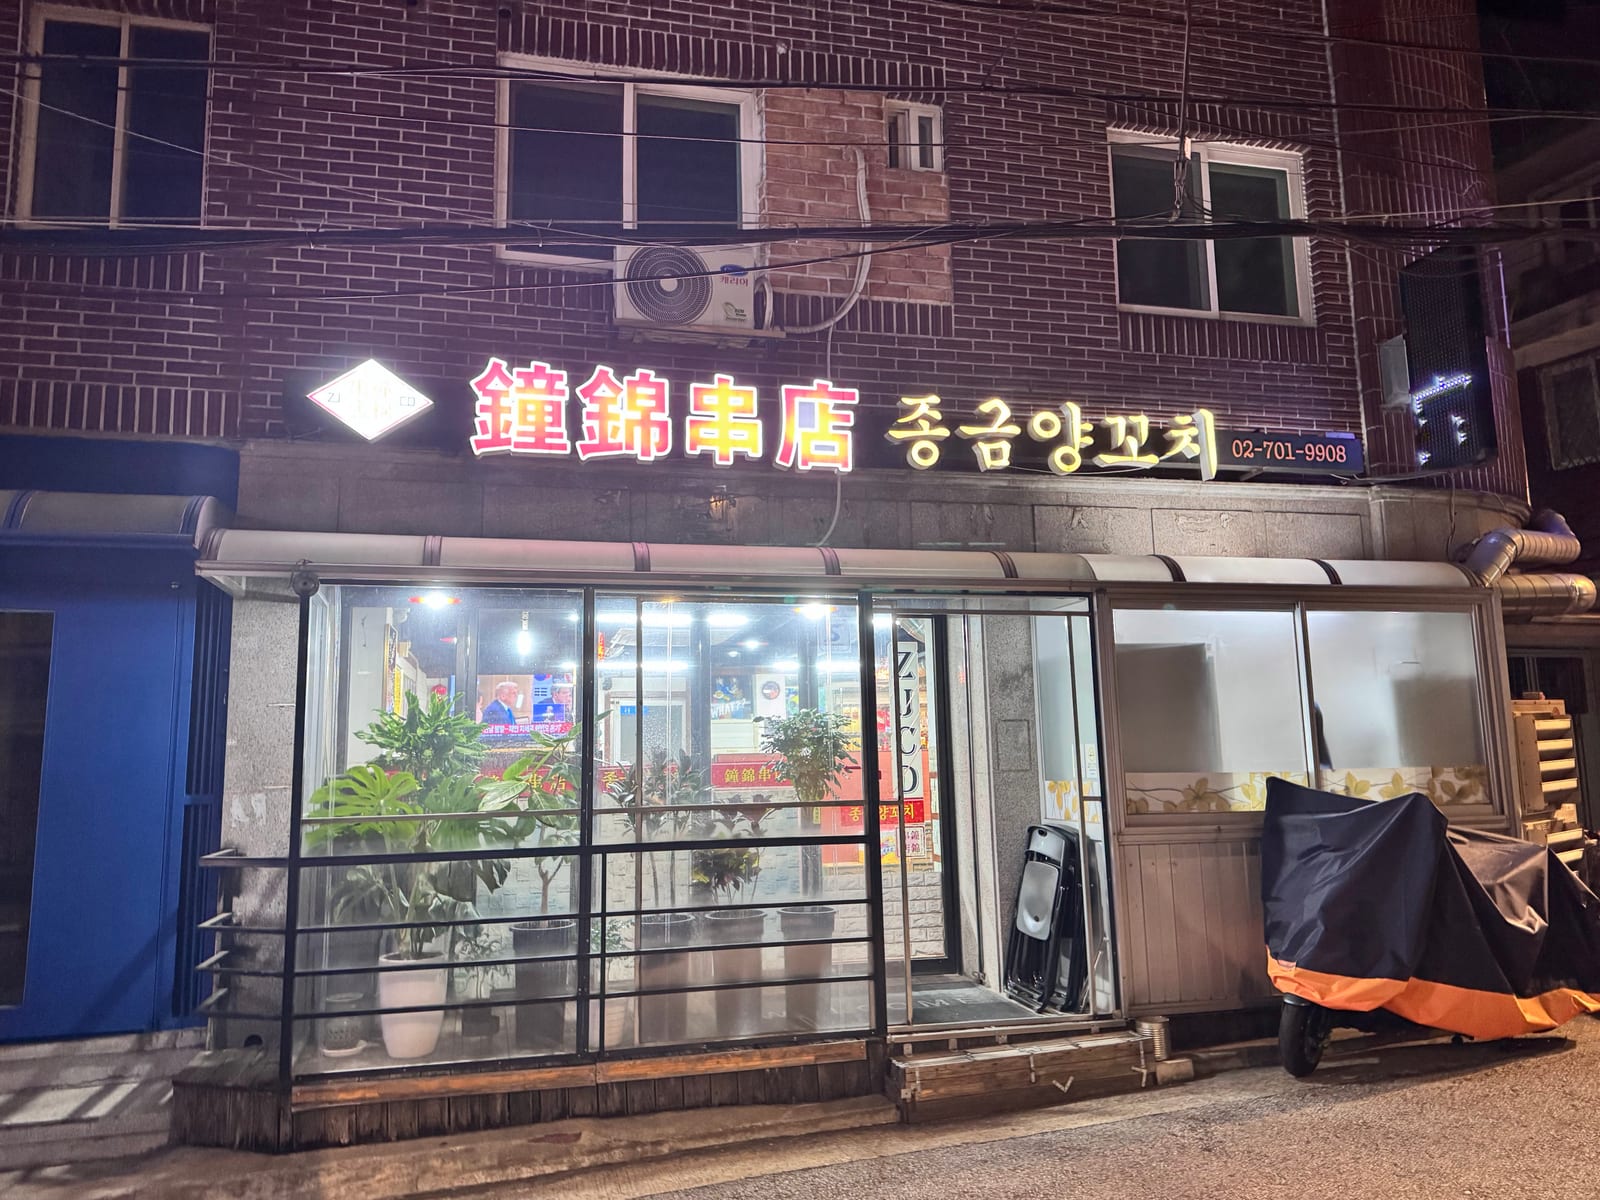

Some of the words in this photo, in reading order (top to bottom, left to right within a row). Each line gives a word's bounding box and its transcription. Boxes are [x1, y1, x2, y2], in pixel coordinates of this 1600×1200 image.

[469, 356, 859, 472] 鐘錦串店
[885, 394, 1218, 481] 종금양꼬치
[1231, 438, 1347, 463] 02-701-9908
[724, 767, 783, 784] 鐘錦串
[848, 802, 914, 821] 종양꼬치
